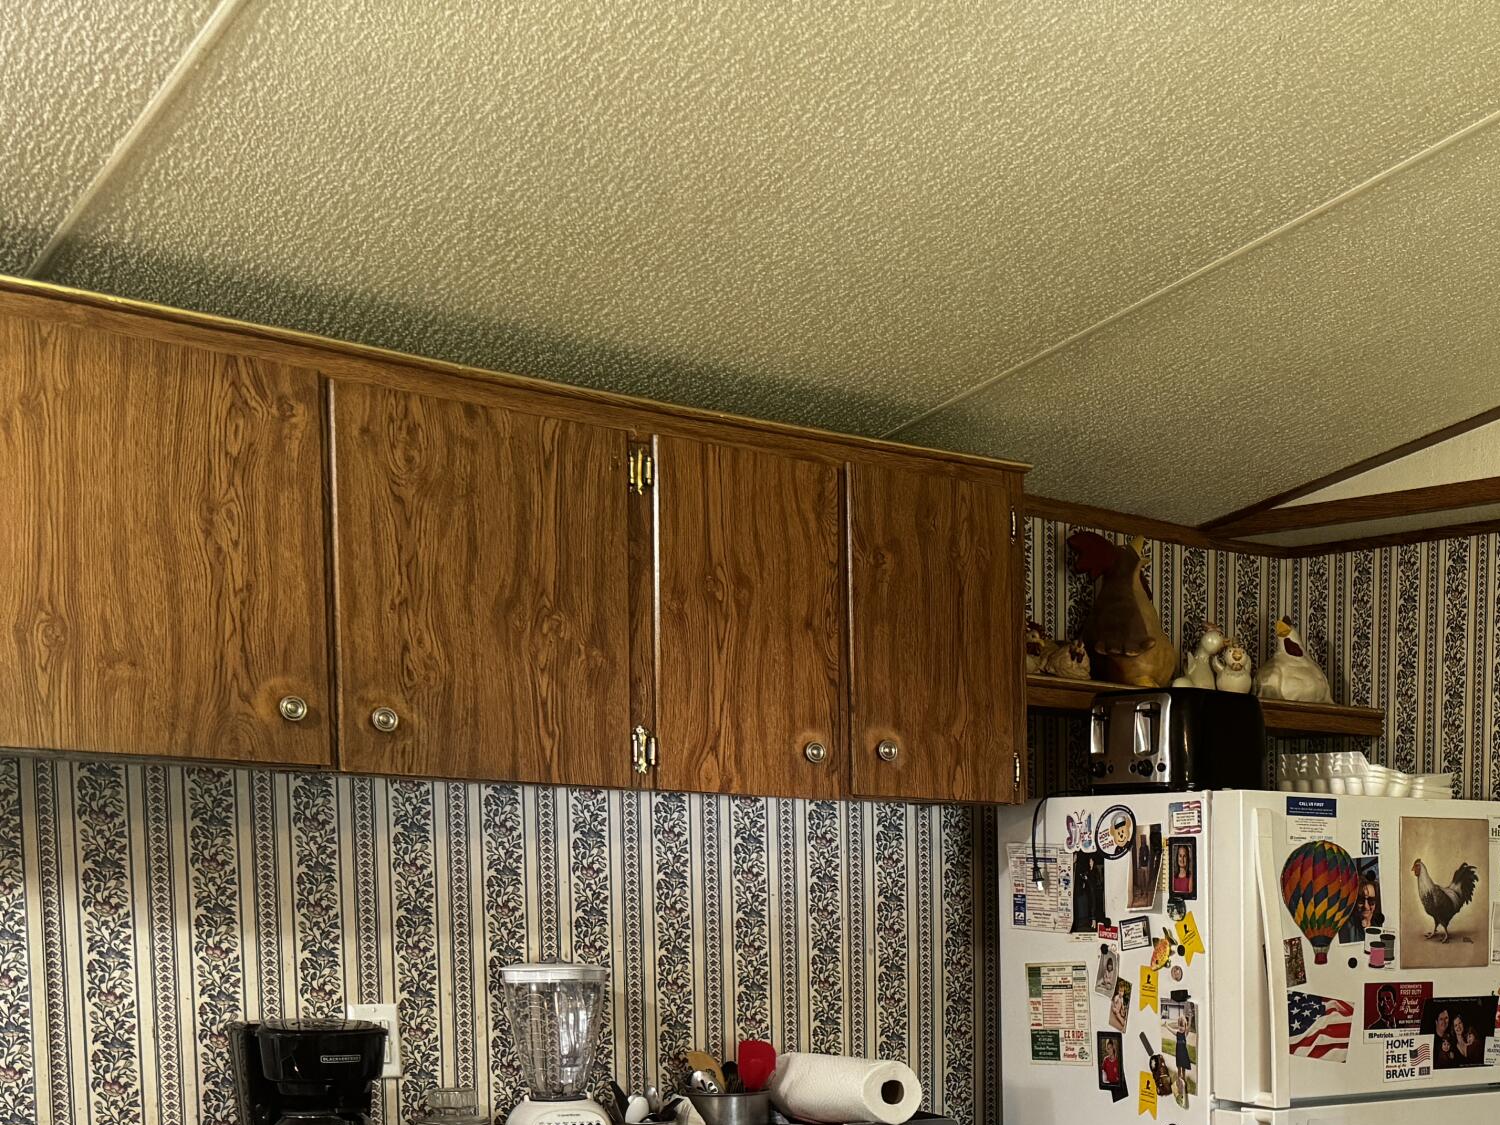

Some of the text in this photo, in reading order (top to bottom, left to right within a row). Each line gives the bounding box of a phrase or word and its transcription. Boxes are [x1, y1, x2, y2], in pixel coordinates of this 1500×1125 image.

[1361, 828, 1370, 840] BE
[1361, 840, 1379, 855] ONE
[1072, 1030, 1084, 1038] RIDE
[1386, 1039, 1414, 1049] HOME
[1386, 1054, 1407, 1064] FREE
[1386, 1068, 1415, 1079] BRAVE
